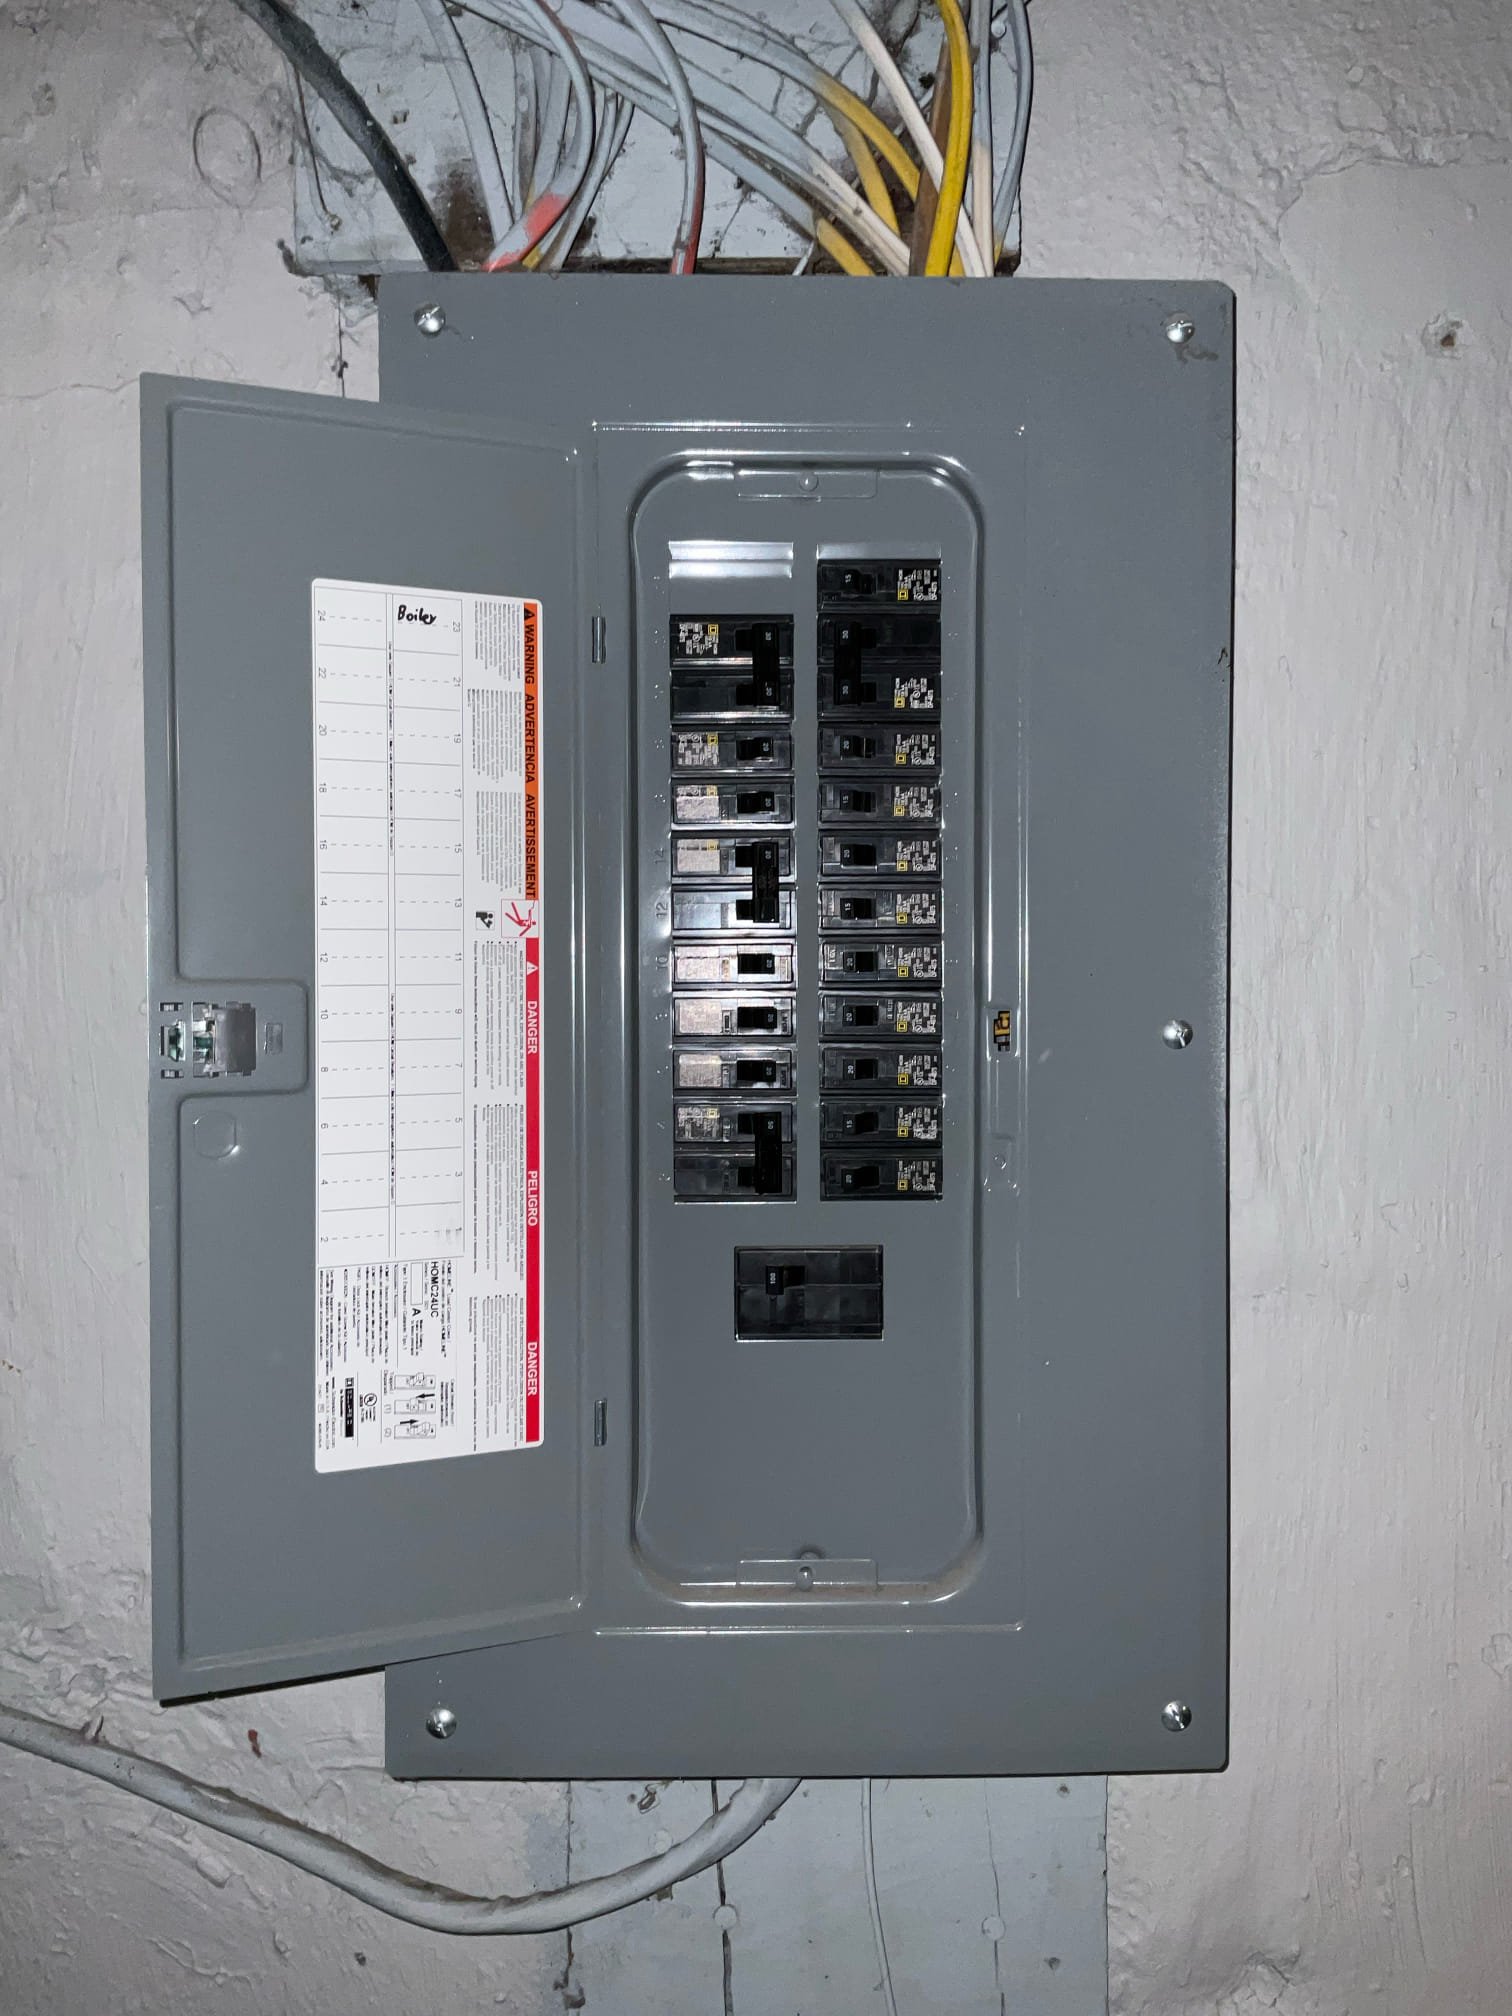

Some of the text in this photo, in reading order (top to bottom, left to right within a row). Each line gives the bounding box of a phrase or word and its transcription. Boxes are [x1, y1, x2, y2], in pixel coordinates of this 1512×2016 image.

[844, 574, 851, 583] 15
[318, 610, 327, 621] 24
[453, 621, 461, 633] 23
[525, 624, 535, 684] WARNING
[318, 667, 327, 679] 22
[453, 677, 461, 688] 21
[318, 725, 327, 736] 20
[453, 733, 461, 744] 19
[525, 694, 536, 783] ADVERTENCIA
[843, 740, 849, 750] 20
[318, 783, 327, 793] 18
[453, 789, 461, 798] 17
[842, 796, 848, 804] 15
[318, 839, 327, 849] 16
[453, 843, 461, 853] 15
[525, 794, 536, 897] AVERTISSEMENT
[318, 896, 327, 906] 14
[453, 898, 461, 908] 13
[844, 903, 850, 911] 15
[320, 952, 328, 962] 12
[456, 953, 462, 961] 11
[321, 1009, 328, 1019] 10
[846, 1013, 853, 1022] 20
[527, 1001, 538, 1054] DANGER
[847, 1065, 854, 1075] 20
[846, 1120, 852, 1128] 15
[527, 1171, 538, 1226] PELIGRO
[430, 1261, 439, 1318] HOMC24UC
[412, 1308, 421, 1316] A
[527, 1341, 537, 1396] DANGER
